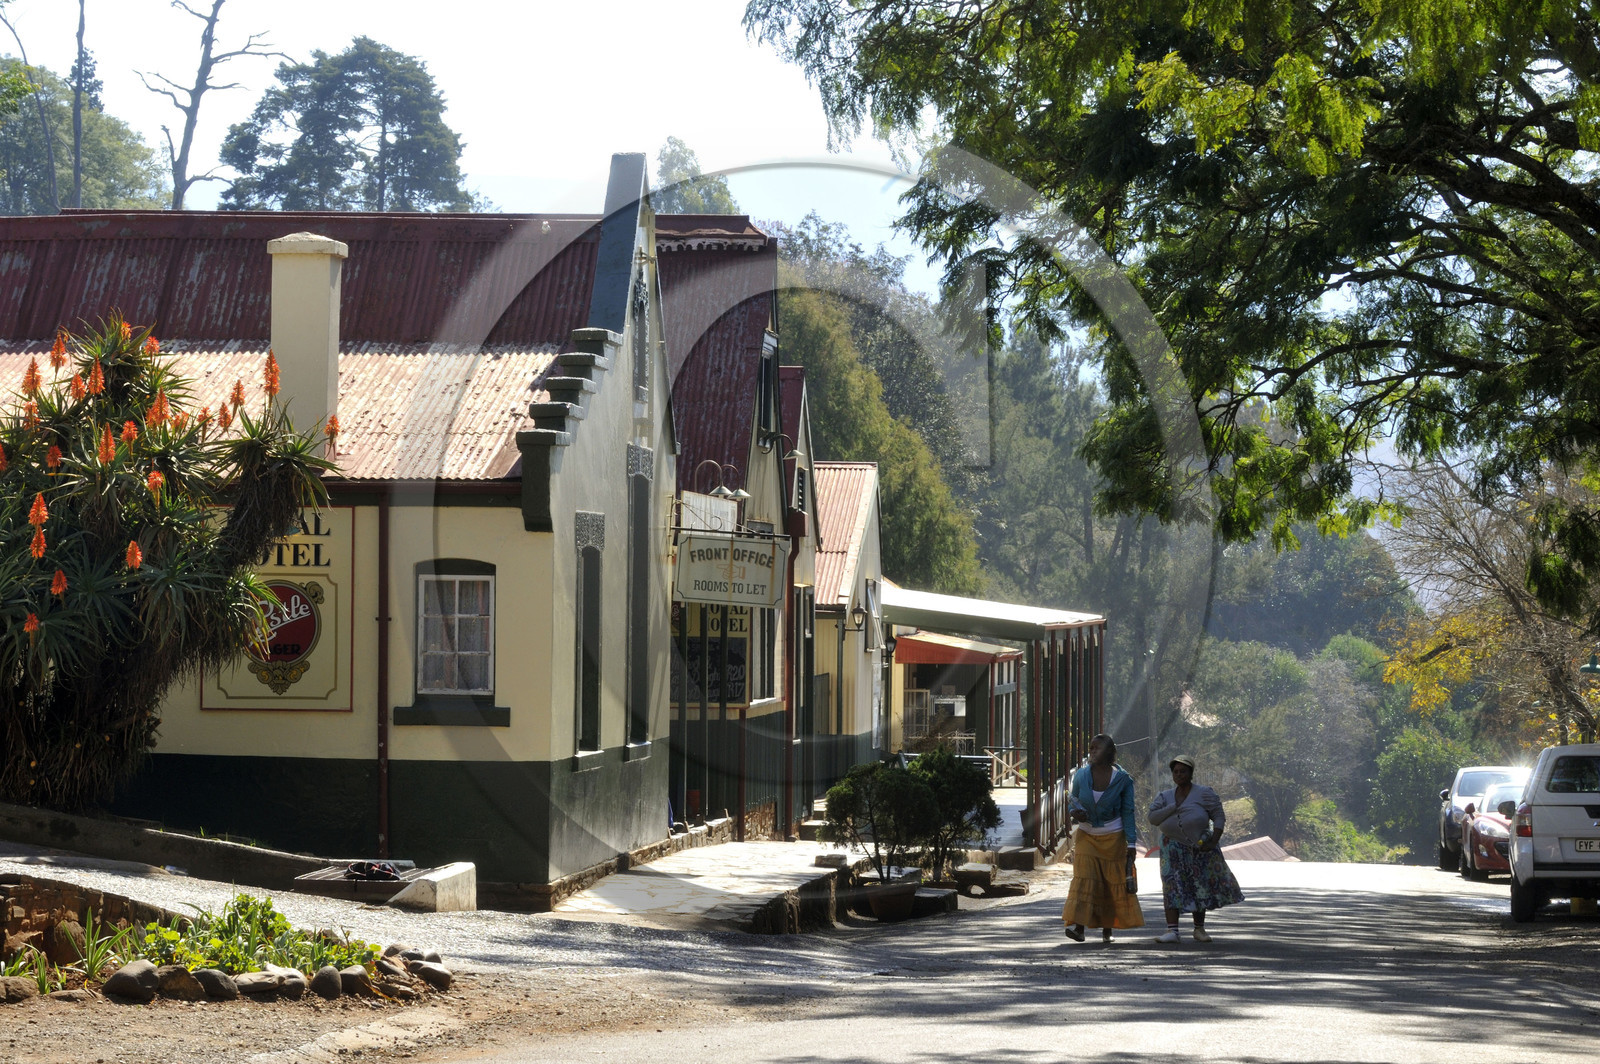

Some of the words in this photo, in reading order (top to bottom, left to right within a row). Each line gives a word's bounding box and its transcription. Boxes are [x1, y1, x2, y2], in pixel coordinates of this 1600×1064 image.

[256, 543, 331, 566] TEL
[690, 547, 729, 563] FRONT
[733, 548, 774, 568] OFFICE
[693, 580, 728, 593] ROOMS
[732, 583, 744, 594] TO
[746, 583, 767, 595] LET
[269, 643, 301, 655] GER
